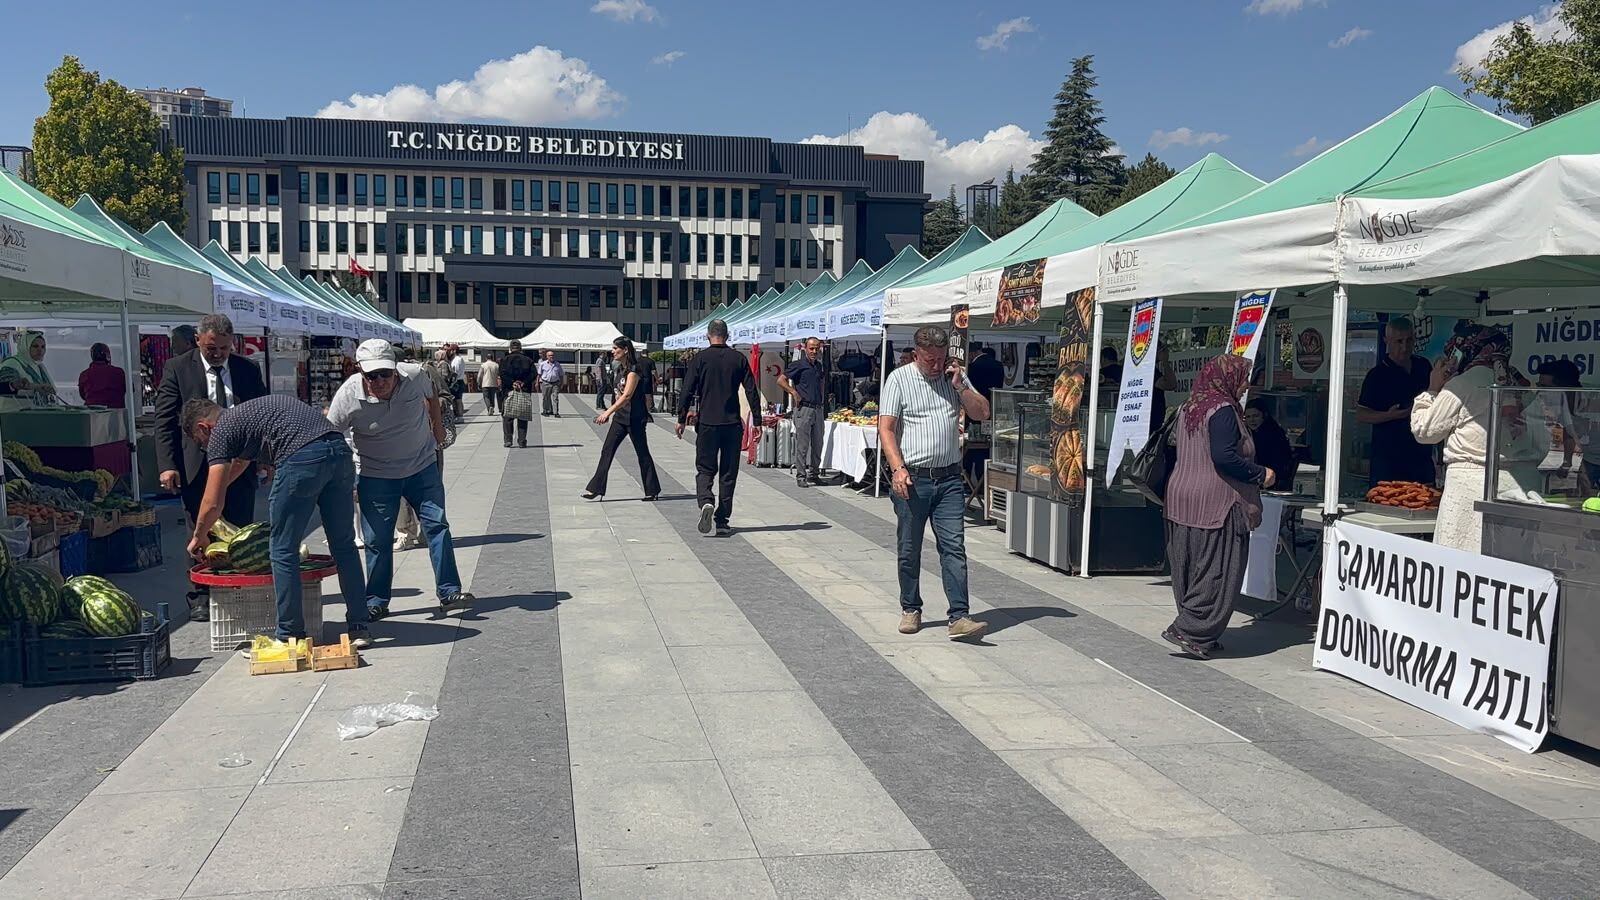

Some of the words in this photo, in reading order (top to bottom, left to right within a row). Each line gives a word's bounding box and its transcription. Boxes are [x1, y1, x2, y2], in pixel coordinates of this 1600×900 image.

[387, 131, 432, 149] T.C.
[436, 128, 521, 153] NİĞDE
[528, 136, 684, 160] BELEDİYESİ
[1127, 378, 1143, 388] NİĞDE
[1124, 402, 1142, 412] ESNAF
[1122, 414, 1139, 423] ODASI
[1337, 540, 1444, 613] ÇAMARDI
[1453, 570, 1548, 645] PETEK
[1320, 608, 1458, 699] DONDURMA
[1463, 657, 1547, 734] TATLI
